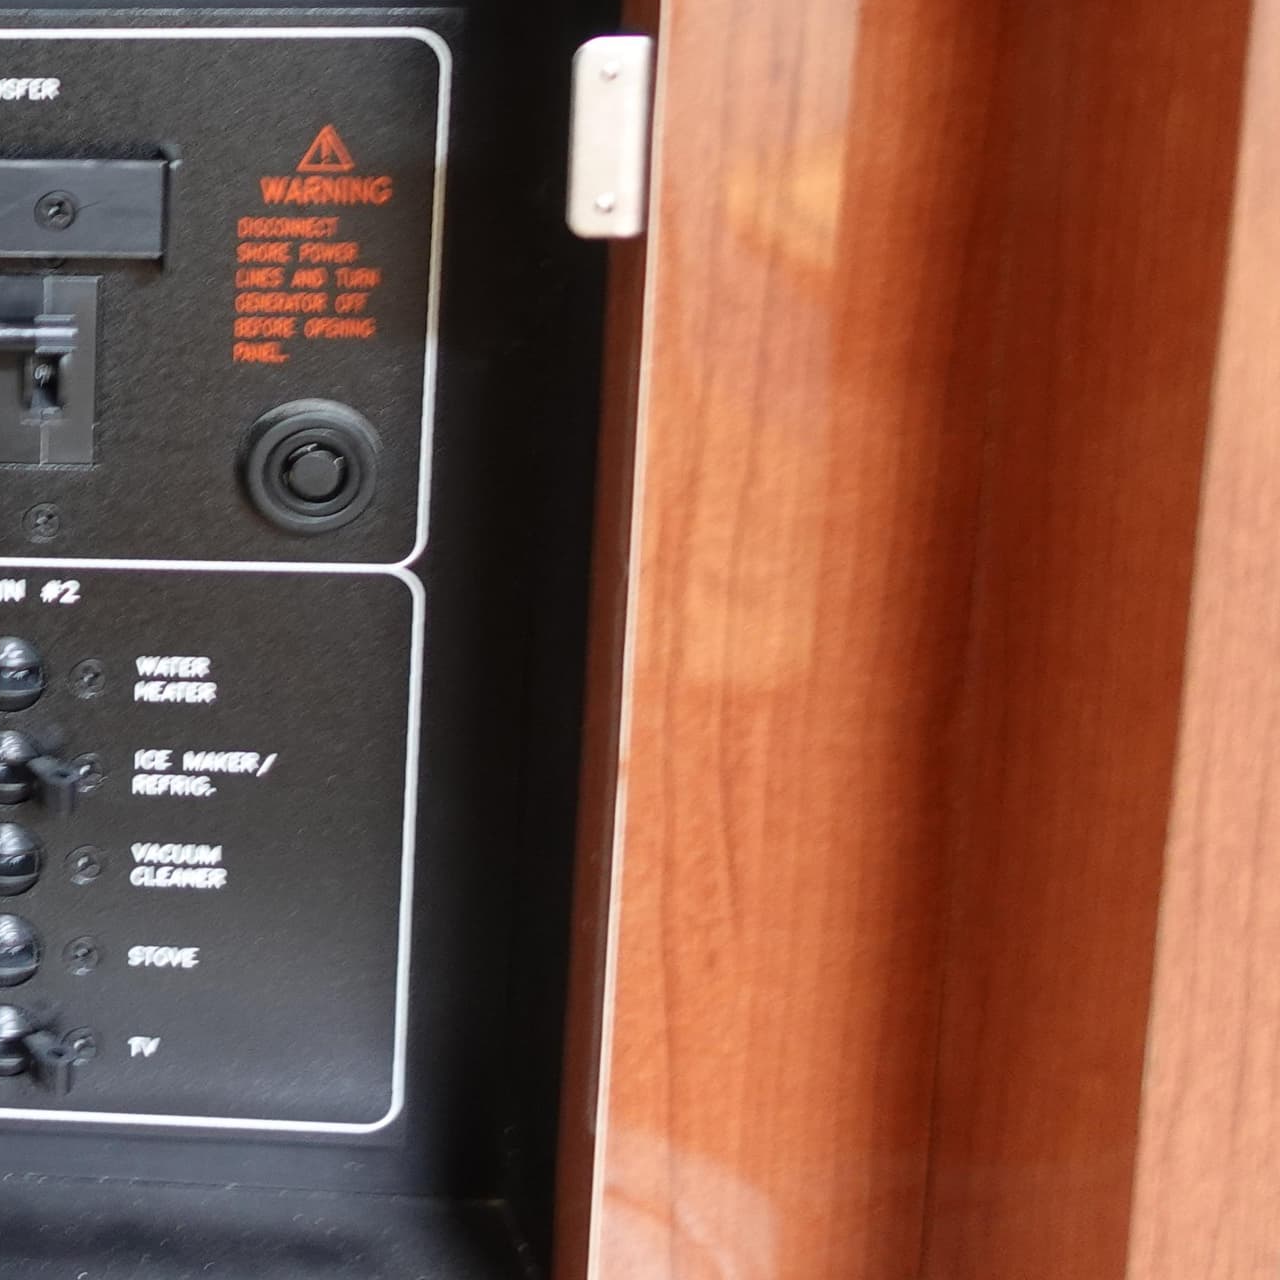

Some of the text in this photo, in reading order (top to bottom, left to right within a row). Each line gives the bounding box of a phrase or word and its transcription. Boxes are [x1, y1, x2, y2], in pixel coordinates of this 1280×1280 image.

[259, 174, 394, 206] WARNING
[40, 580, 80, 604] #2
[136, 656, 210, 678] WATER
[134, 680, 217, 703] HEATER
[134, 749, 173, 771] ICE
[131, 843, 222, 866] VACUUM
[130, 866, 227, 889] CLEANER
[128, 945, 200, 969] STOVE
[127, 1036, 161, 1058] TV
